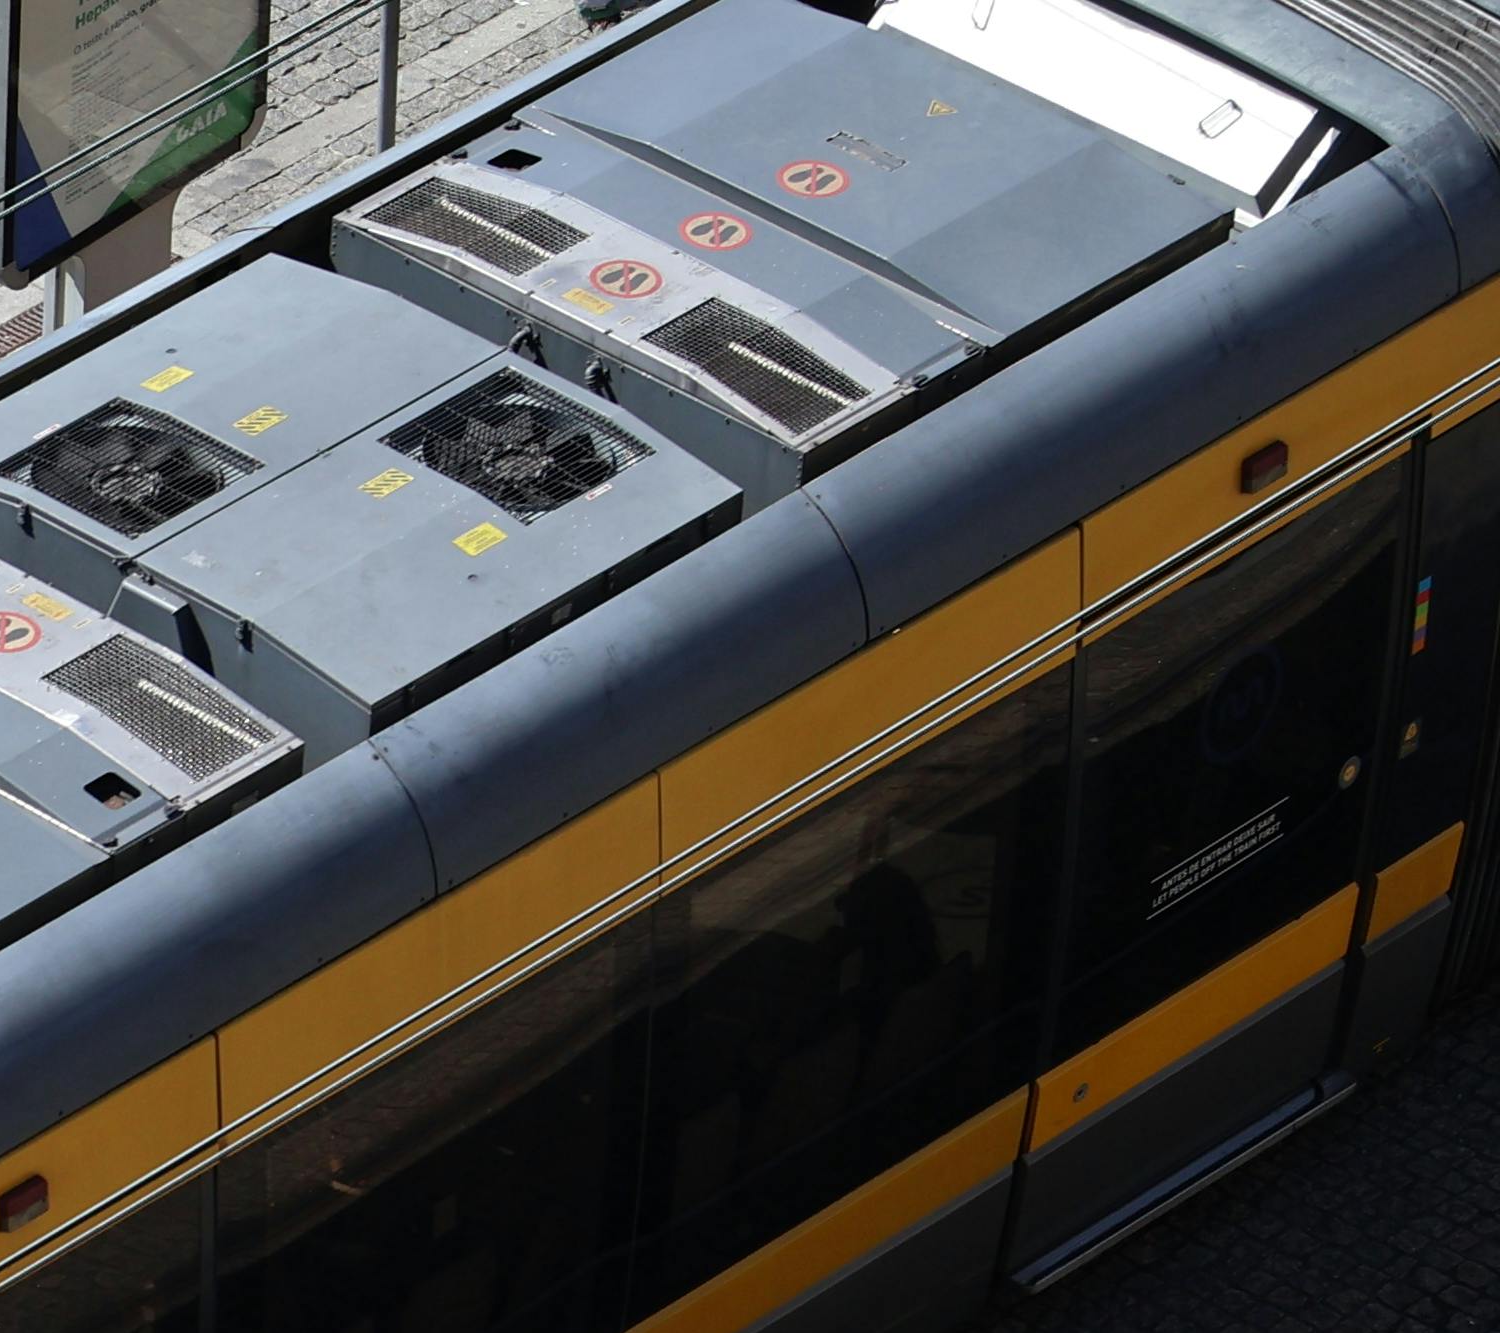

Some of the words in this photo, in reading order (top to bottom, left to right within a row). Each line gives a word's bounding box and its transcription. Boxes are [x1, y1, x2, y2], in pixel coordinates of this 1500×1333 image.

[1152, 891, 1168, 908] LET
[1168, 872, 1199, 897] PEOPLE
[1200, 861, 1216, 878] OFF
[1217, 851, 1233, 867] THE
[1234, 836, 1258, 857] TRAIN
[1258, 821, 1282, 842] FIRST
[1161, 868, 1188, 890] ANTES
[1188, 860, 1200, 874] DE
[1200, 841, 1232, 867] ENTRAR
